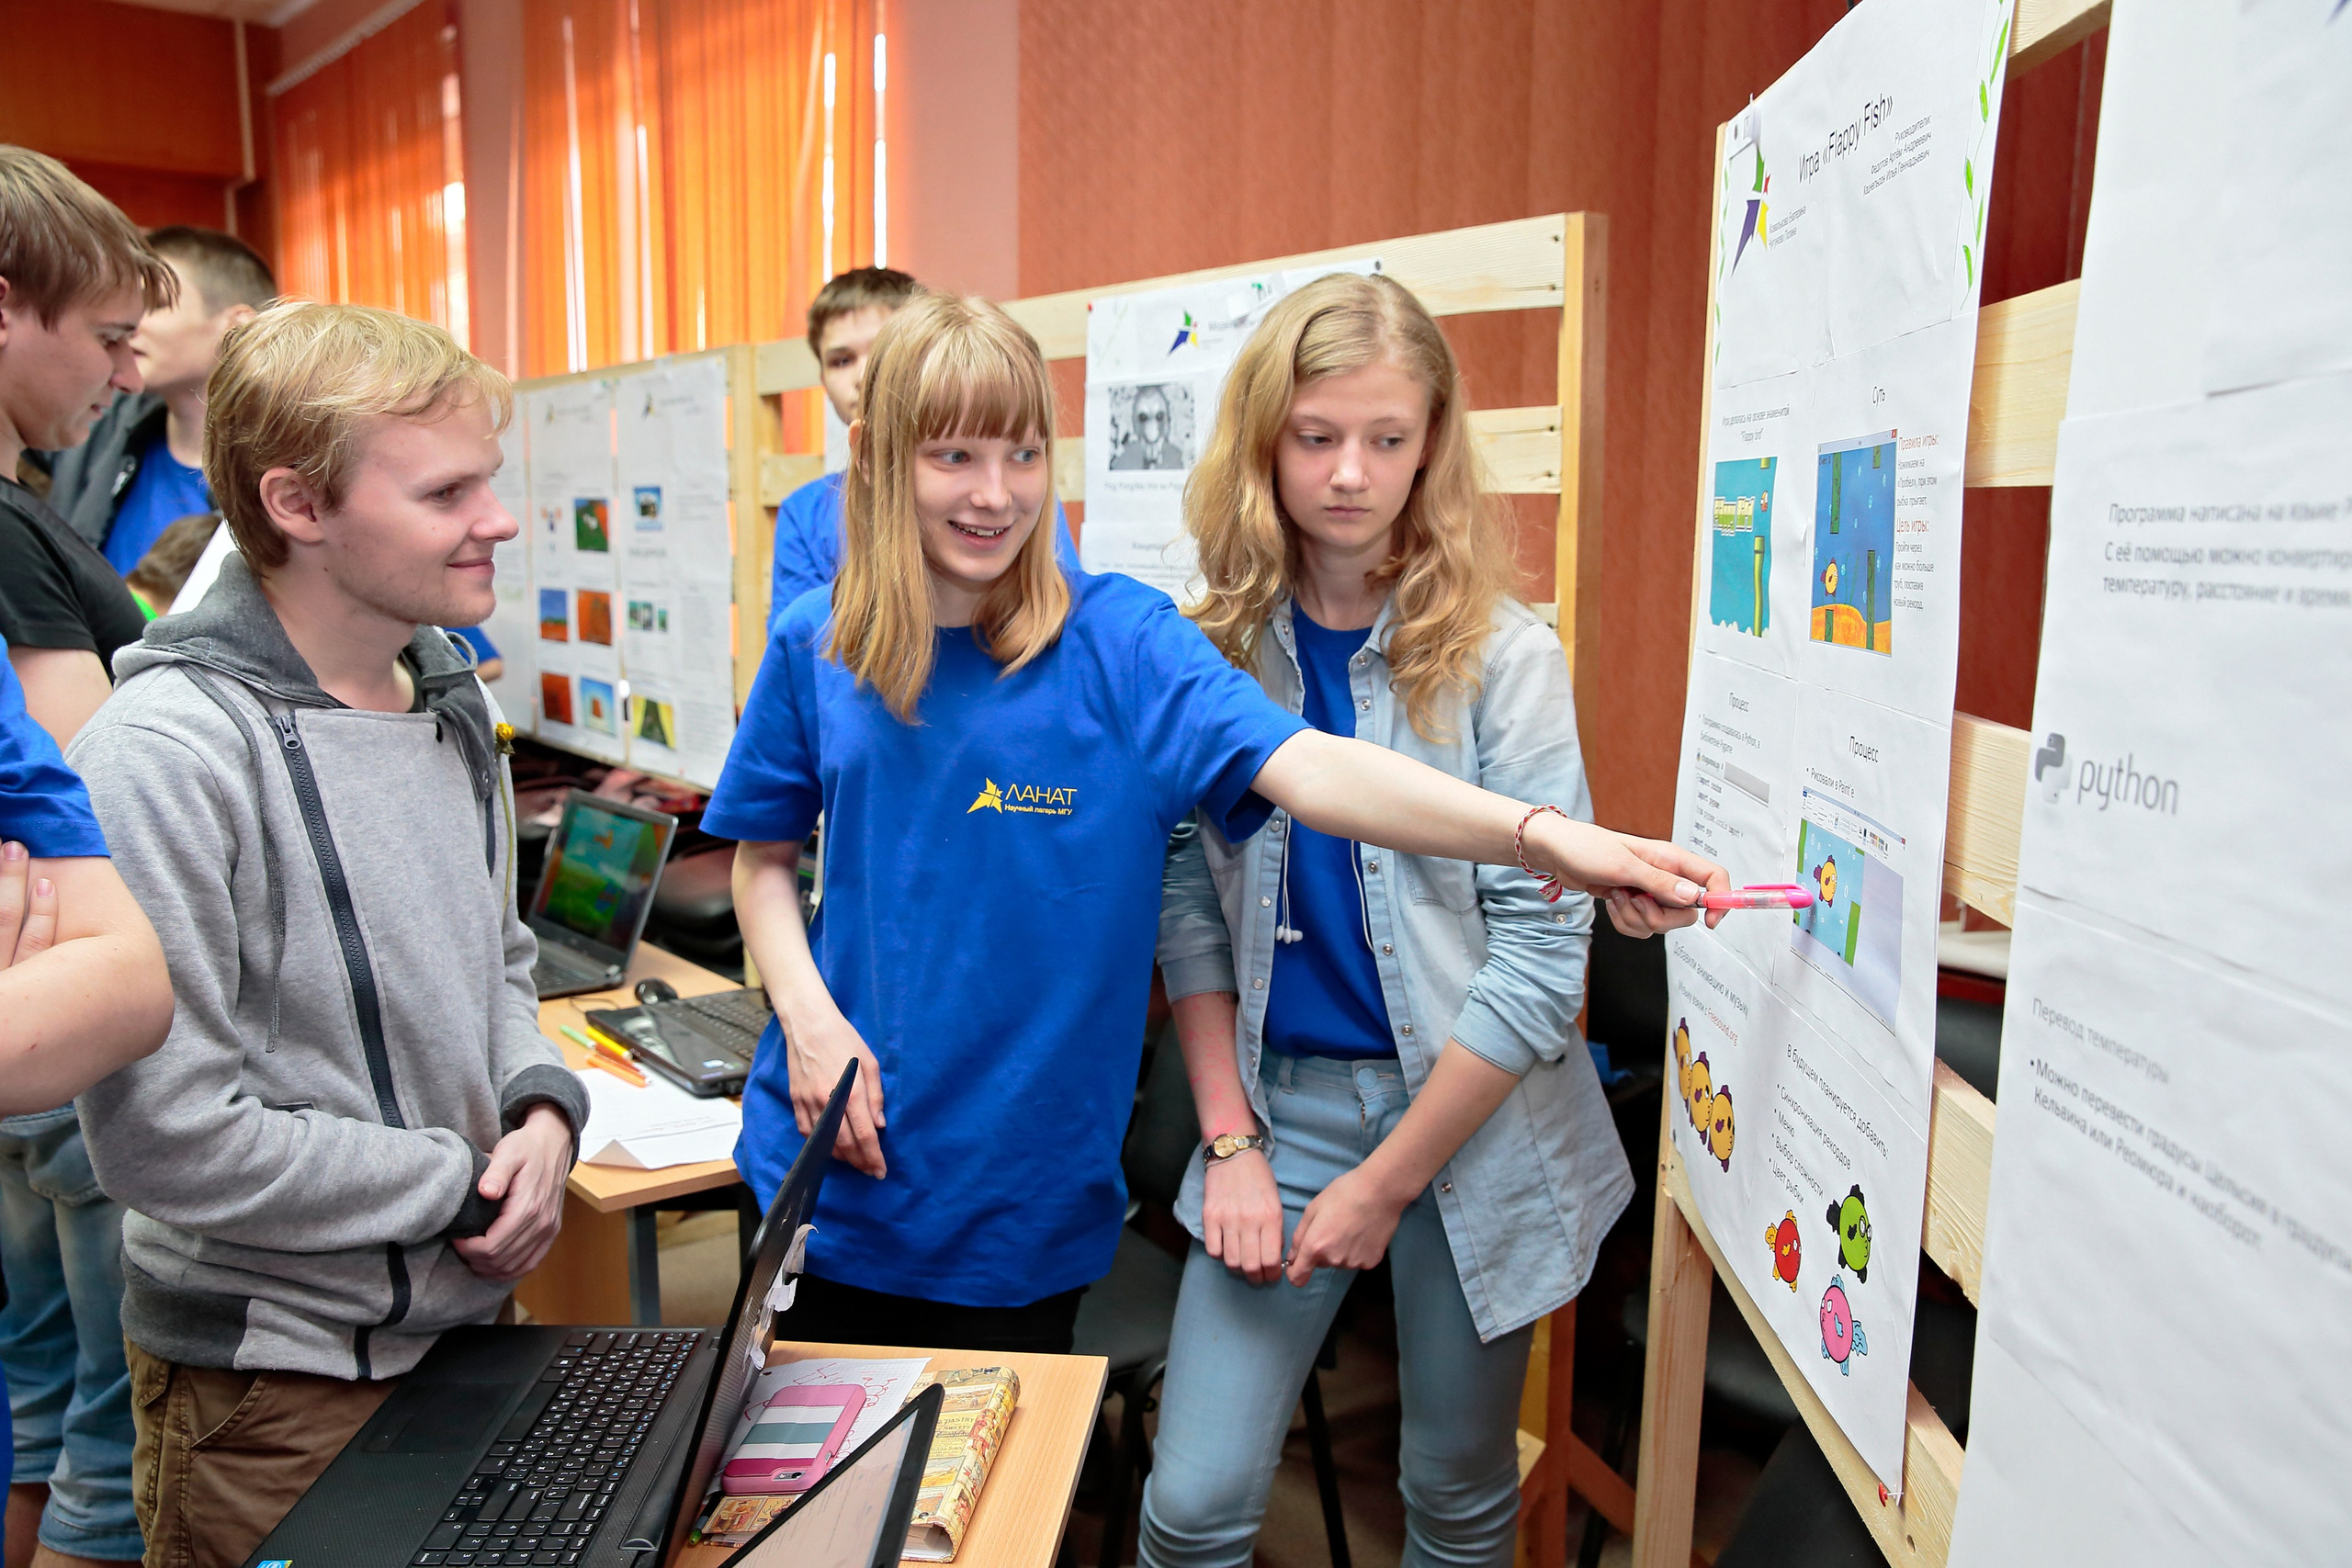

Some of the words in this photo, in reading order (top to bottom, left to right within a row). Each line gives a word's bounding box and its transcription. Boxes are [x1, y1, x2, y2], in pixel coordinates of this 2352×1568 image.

[1799, 152, 1819, 185] Игра
[1822, 118, 1861, 165] «Flappy
[1863, 93, 1894, 136] Fish»
[1872, 386, 1886, 407] Суть
[1898, 436, 1921, 454] Правила
[1922, 434, 1939, 450] игры:
[1896, 517, 1910, 536] Цель
[1911, 520, 1929, 536] игры:
[2109, 502, 2186, 527] Программа
[2104, 541, 2114, 561] С
[2116, 541, 2132, 562] её
[2134, 546, 2204, 568] помощью
[2208, 547, 2261, 566] можно
[1729, 692, 1749, 712] Процесс
[1849, 735, 1879, 762] Процесс
[1811, 767, 1835, 789] Рисовали
[2077, 753, 2179, 815] python
[1004, 783, 1078, 806] ЛАНАТ
[1004, 804, 1034, 813] Научный
[1034, 807, 1057, 816] лагерь
[1057, 807, 1073, 816] МГУ
[1674, 941, 1697, 969] Добавили
[2031, 997, 2085, 1042] Перевод
[2086, 1024, 2170, 1085] температуры
[1787, 1043, 1792, 1057] В
[1792, 1048, 1819, 1085] будущем
[1819, 1077, 1857, 1124] планируется
[1856, 1118, 1889, 1160] добавить:
[1778, 1111, 1795, 1138] Меню
[1781, 1087, 1823, 1139] Синхронизация
[1822, 1134, 1851, 1170] рекордов
[2035, 1057, 2079, 1098] Можно
[2080, 1086, 2144, 1138] перевести
[2145, 1126, 2202, 1175] градусы
[2033, 1085, 2087, 1135] Кельвина
[2088, 1125, 2113, 1151] или
[2115, 1134, 2176, 1192] Реомюра
[1775, 1135, 1794, 1166] Выбор
[1793, 1159, 1824, 1200] сложности
[1772, 1160, 1787, 1183] Цвет
[1786, 1179, 1804, 1206] рыбки
[944, 1416, 975, 1426] PASTRY
